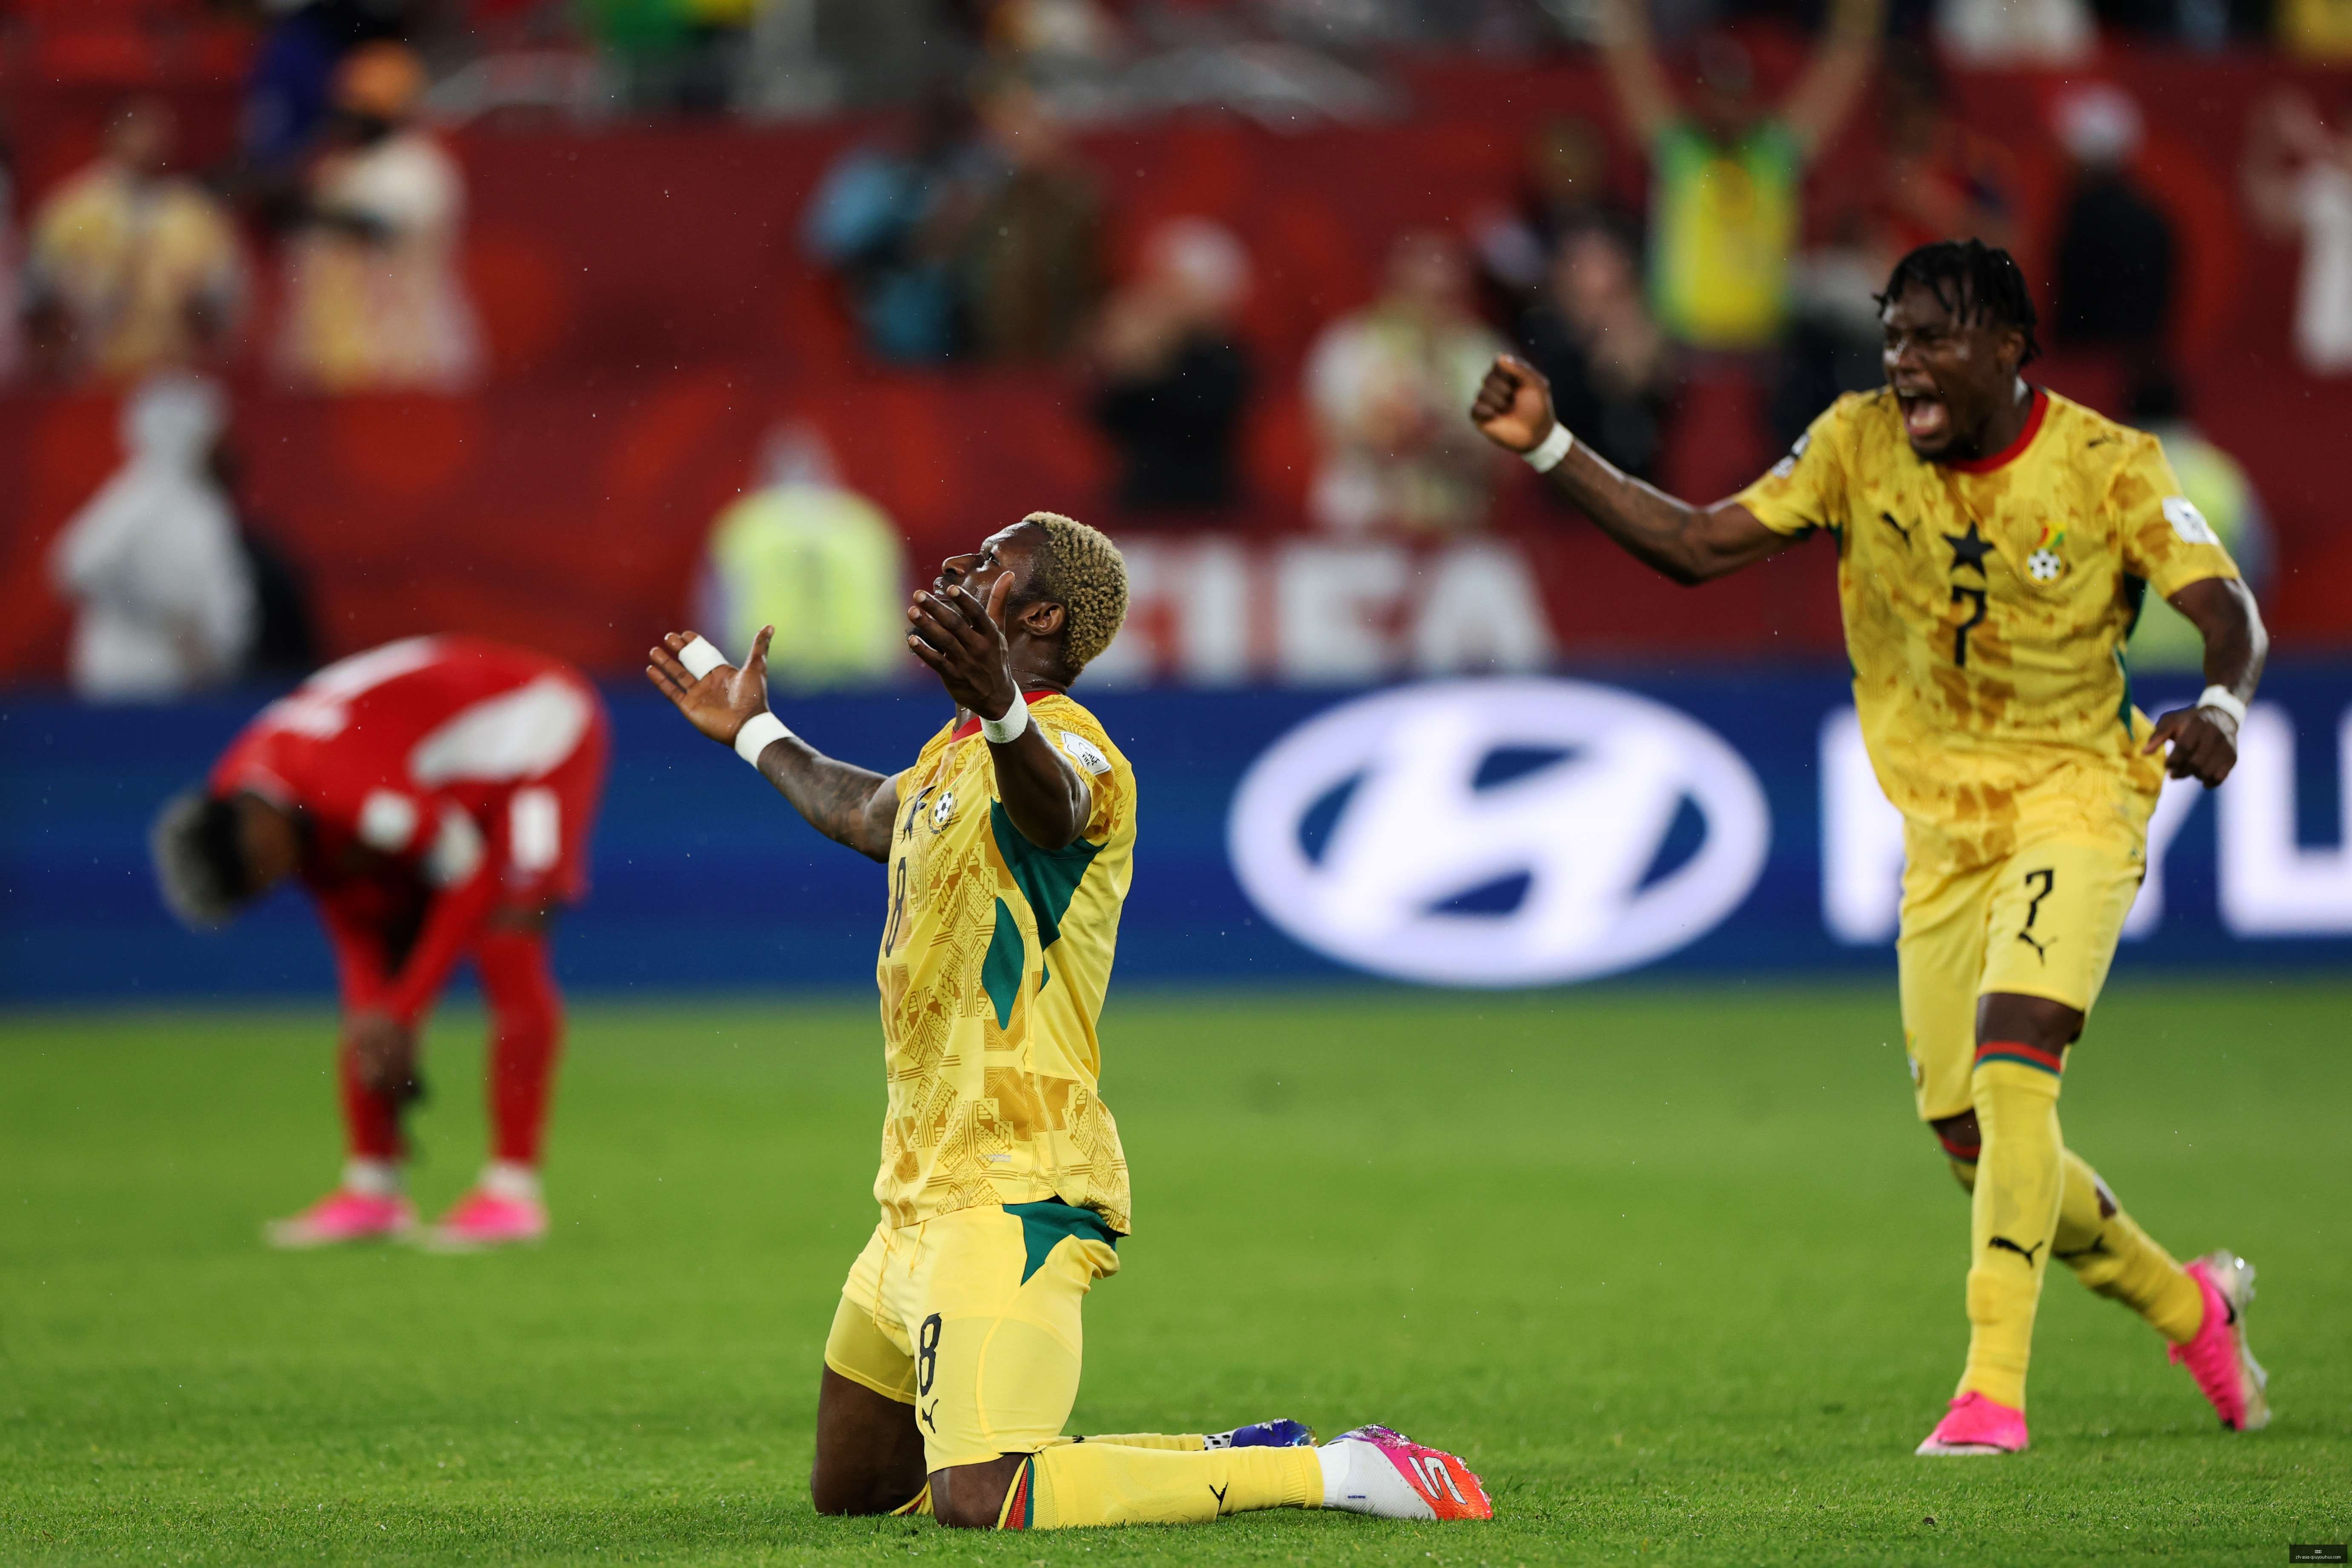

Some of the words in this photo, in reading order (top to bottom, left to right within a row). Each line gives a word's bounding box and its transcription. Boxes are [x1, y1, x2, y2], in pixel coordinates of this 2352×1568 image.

[1951, 585, 1986, 667] 7
[1082, 754, 1090, 767] FIFA
[885, 856, 906, 958] 8
[2025, 869, 2053, 928] 7
[919, 1312, 942, 1398] 8
